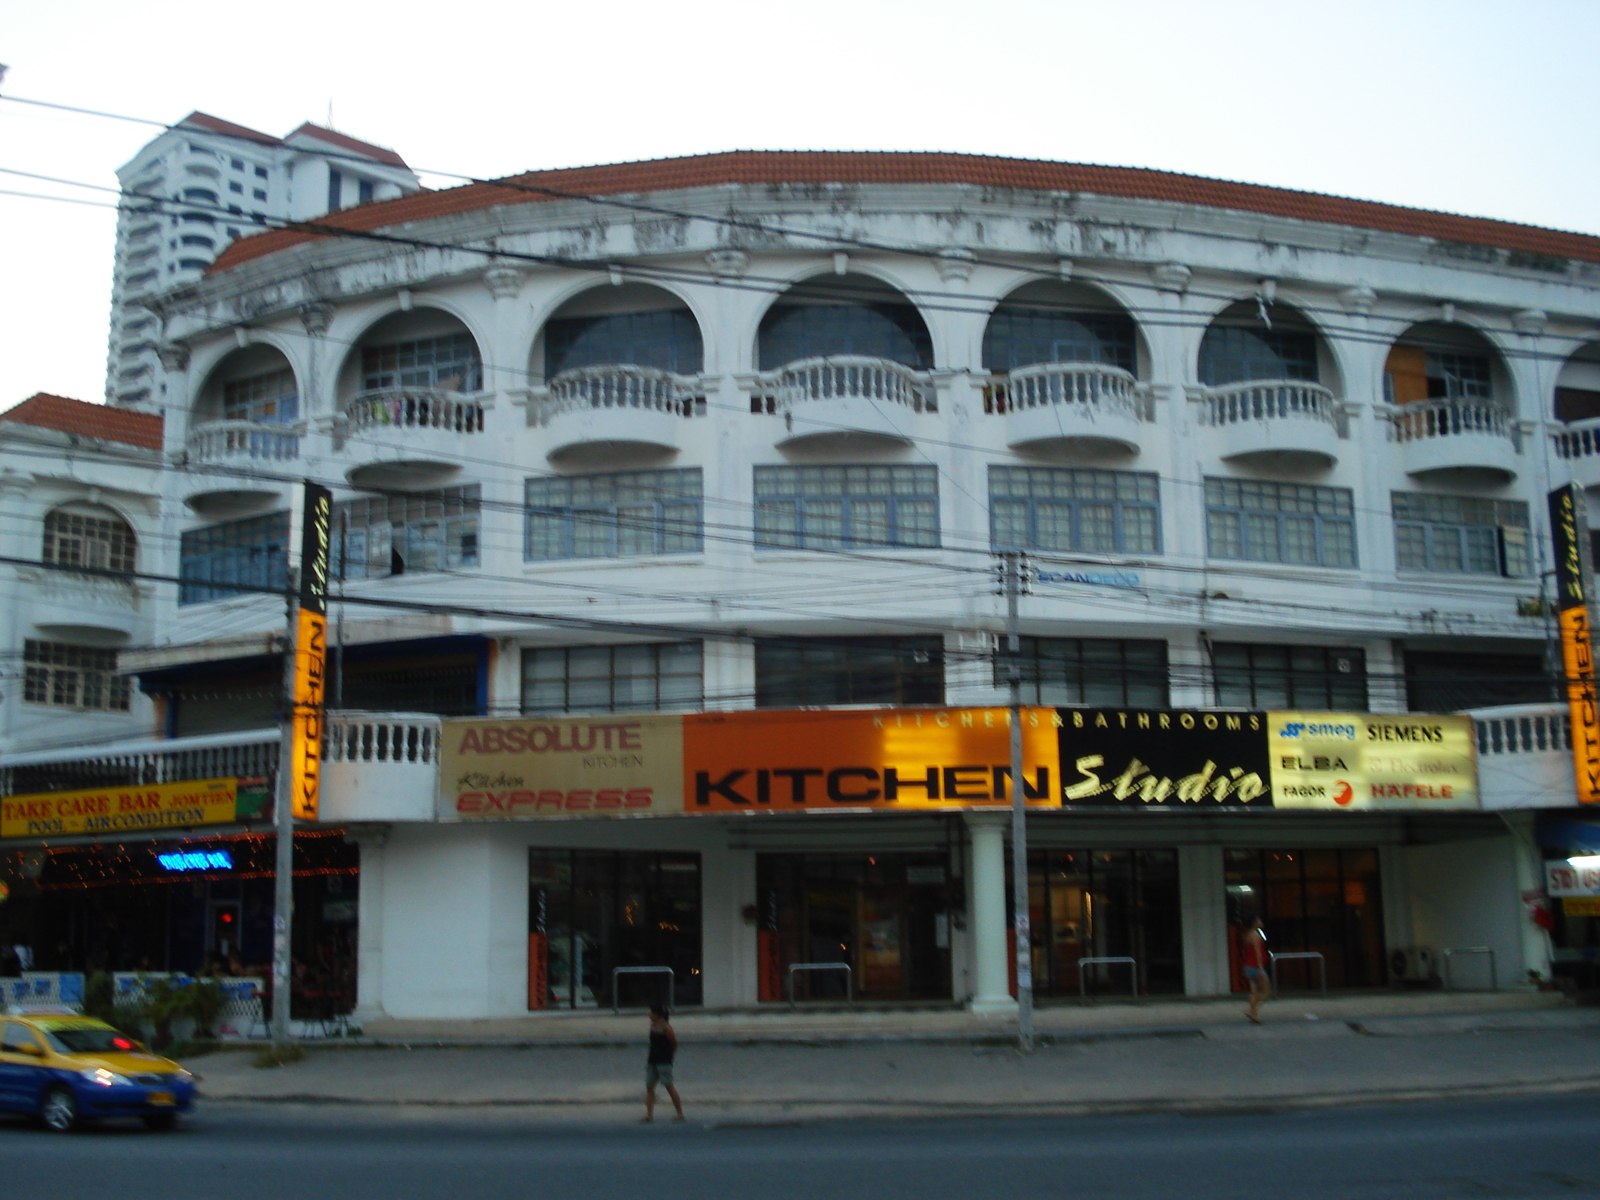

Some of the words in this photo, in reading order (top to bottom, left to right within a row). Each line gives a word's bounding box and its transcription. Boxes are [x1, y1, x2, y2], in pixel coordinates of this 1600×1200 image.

[302, 619, 324, 812] KITCHEN
[1073, 711, 1260, 731] BATHROOMS
[459, 723, 643, 755] ABSOLUTE
[1308, 723, 1356, 741] smeg
[1367, 724, 1443, 742] SIEMENS
[583, 754, 644, 769] KITCHEN
[1281, 755, 1349, 772] ELBA
[456, 771, 525, 790] Kitchen
[695, 765, 1050, 806] KITCHEN
[1064, 754, 1270, 804] Studio
[456, 788, 654, 812] EXPRESS
[1283, 785, 1327, 799] FAGOR
[3, 800, 52, 820] TAKE
[56, 796, 110, 817] CARE
[118, 792, 162, 813] BAR
[28, 818, 66, 834] POOL
